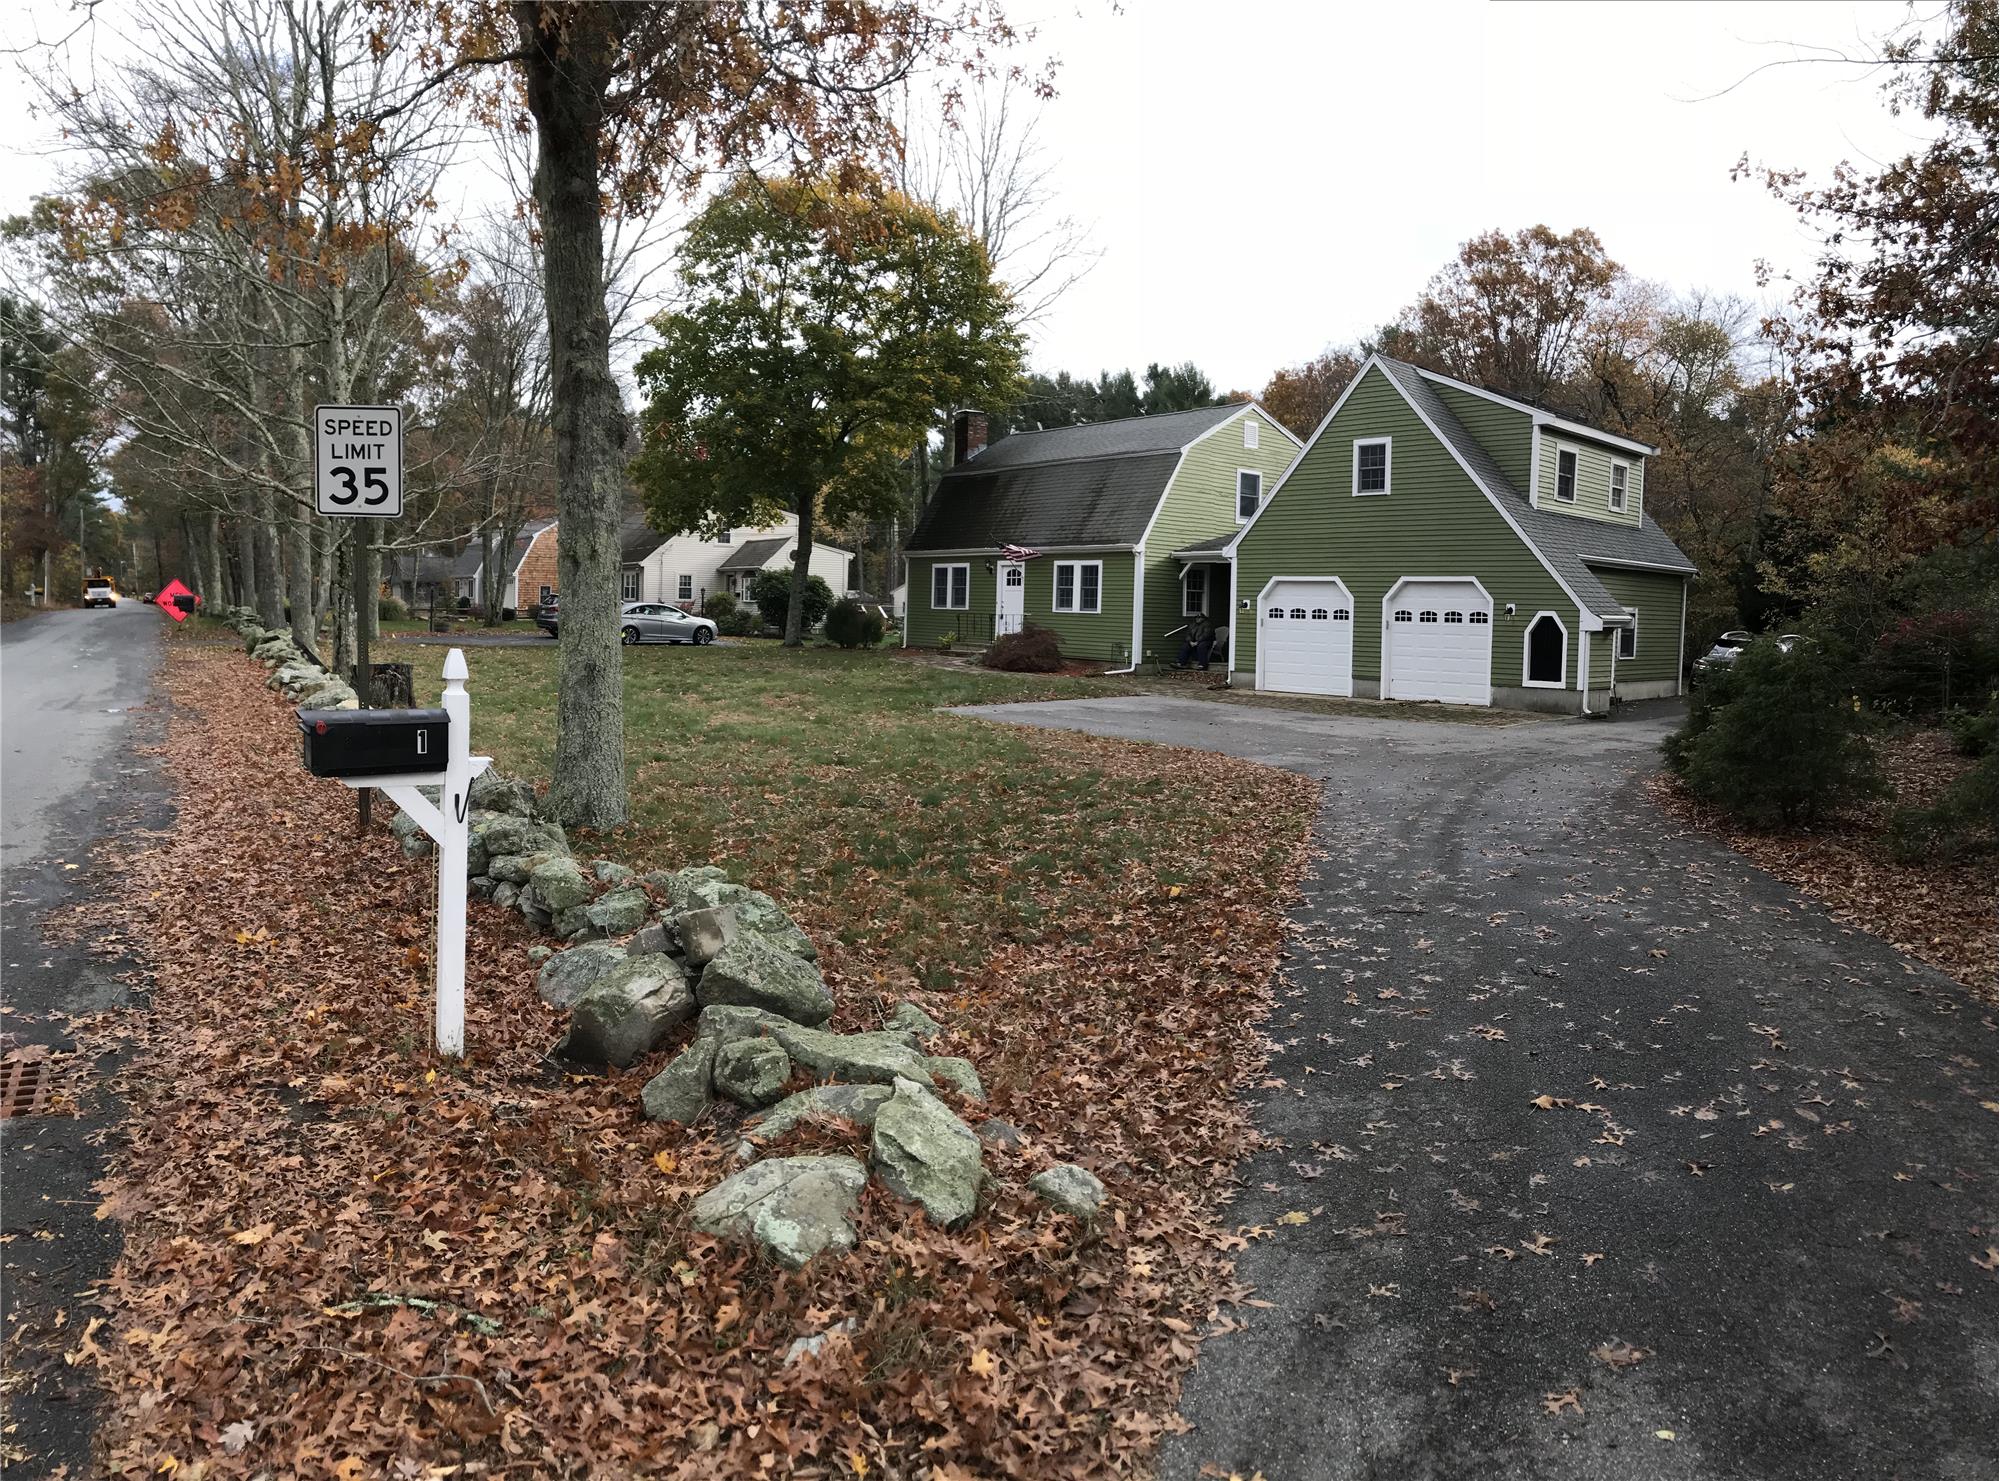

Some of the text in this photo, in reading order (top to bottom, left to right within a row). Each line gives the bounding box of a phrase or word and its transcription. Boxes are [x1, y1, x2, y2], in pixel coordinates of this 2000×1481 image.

[324, 419, 392, 436] SPEED
[331, 443, 385, 460] LIMIT
[328, 466, 389, 506] 35
[417, 729, 428, 755] 1
